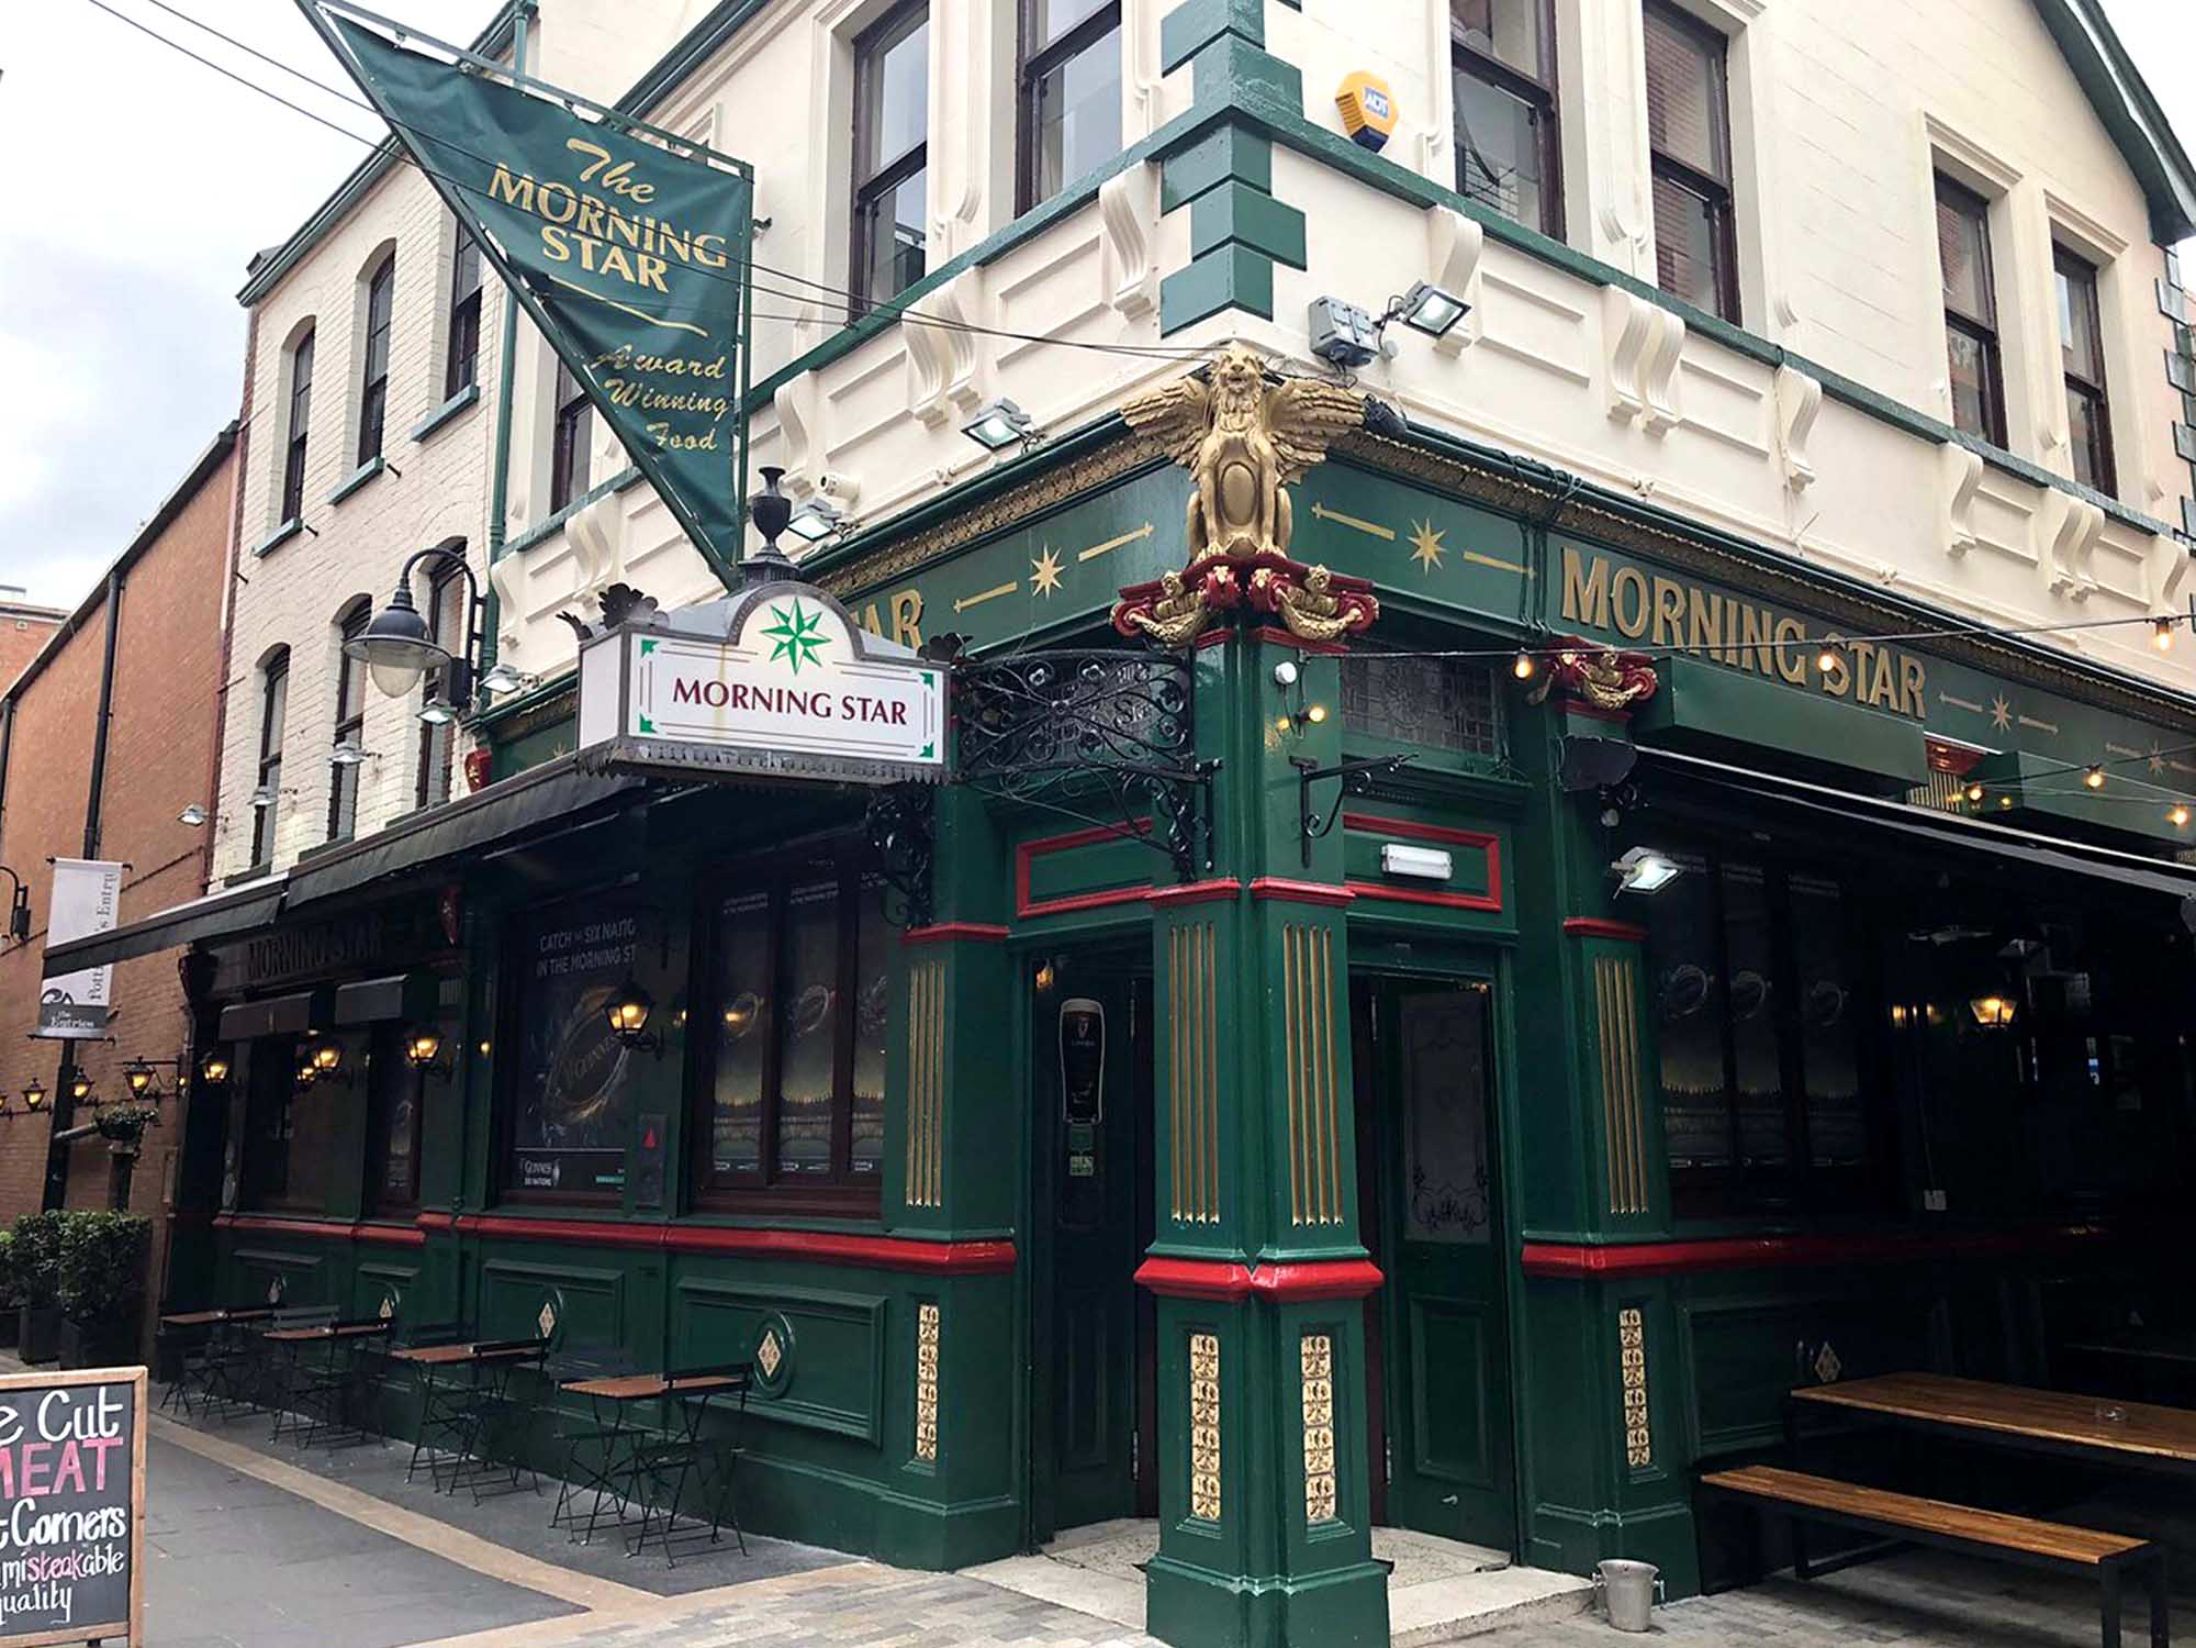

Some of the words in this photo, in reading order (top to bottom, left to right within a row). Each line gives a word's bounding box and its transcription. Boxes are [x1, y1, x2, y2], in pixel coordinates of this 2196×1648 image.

[566, 138, 655, 203] The
[488, 163, 727, 268] MORNING
[541, 226, 669, 293] STAR
[590, 344, 726, 379] Award
[604, 378, 728, 422] Winning
[646, 421, 717, 450] Food
[1561, 547, 1807, 685] MORNING
[1822, 632, 1926, 718] STAR
[673, 677, 831, 719] MORNING
[842, 696, 908, 726] STAR
[38, 1386, 123, 1442] Cut
[11, 1497, 127, 1547] Corners
